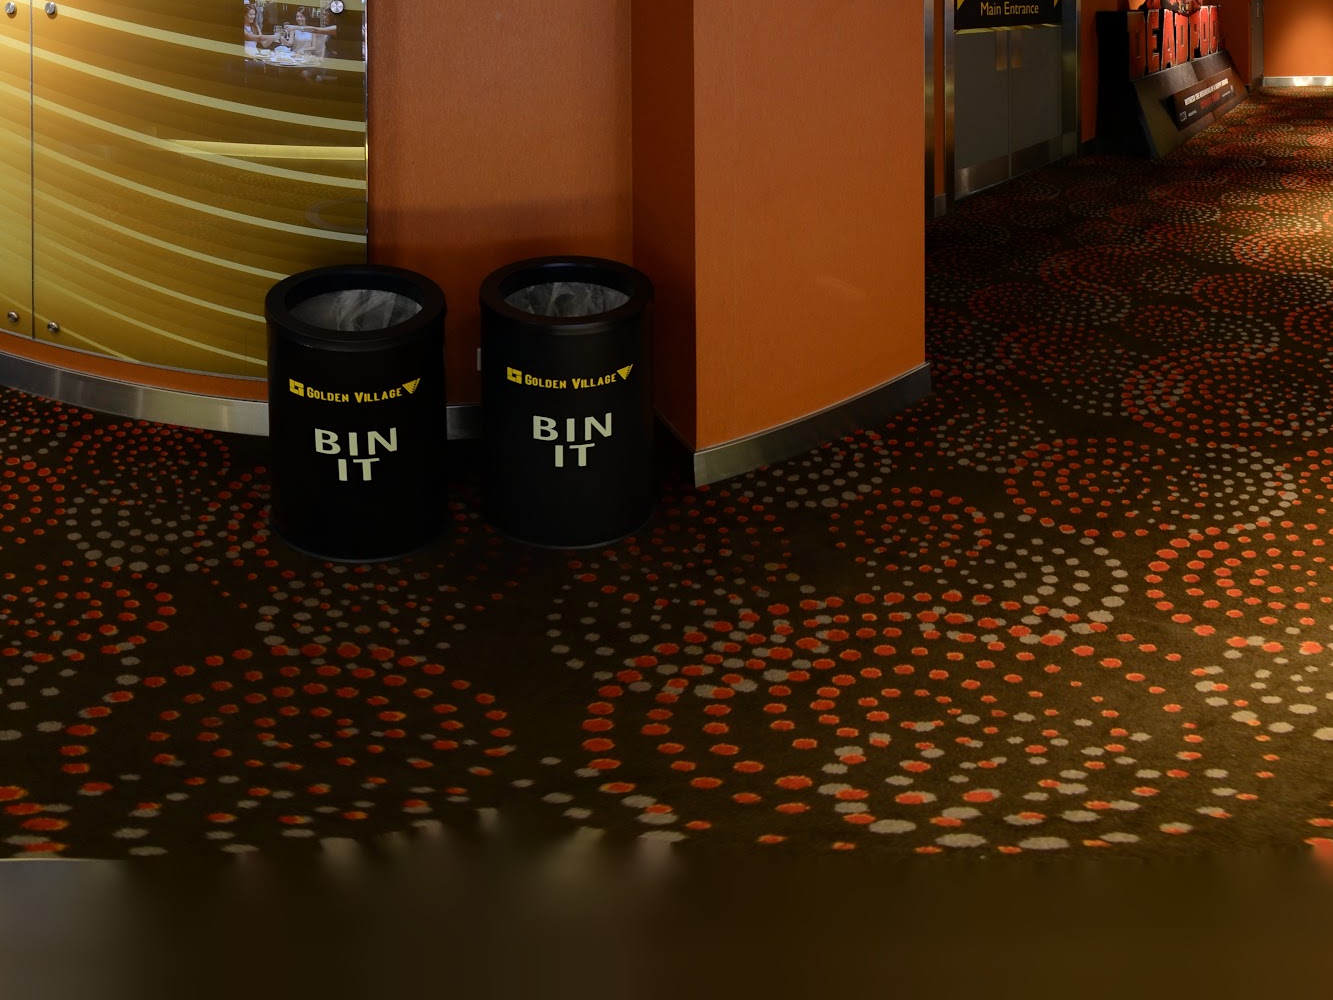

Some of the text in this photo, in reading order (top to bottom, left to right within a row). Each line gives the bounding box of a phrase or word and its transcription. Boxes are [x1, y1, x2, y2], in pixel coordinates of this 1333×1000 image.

[980, 1, 1040, 16] Main Entrance
[1127, 5, 1222, 81] DEADPOO
[532, 412, 612, 443] BIN
[314, 427, 398, 457] BIN
[554, 443, 596, 468] IT
[337, 457, 380, 482] IT
